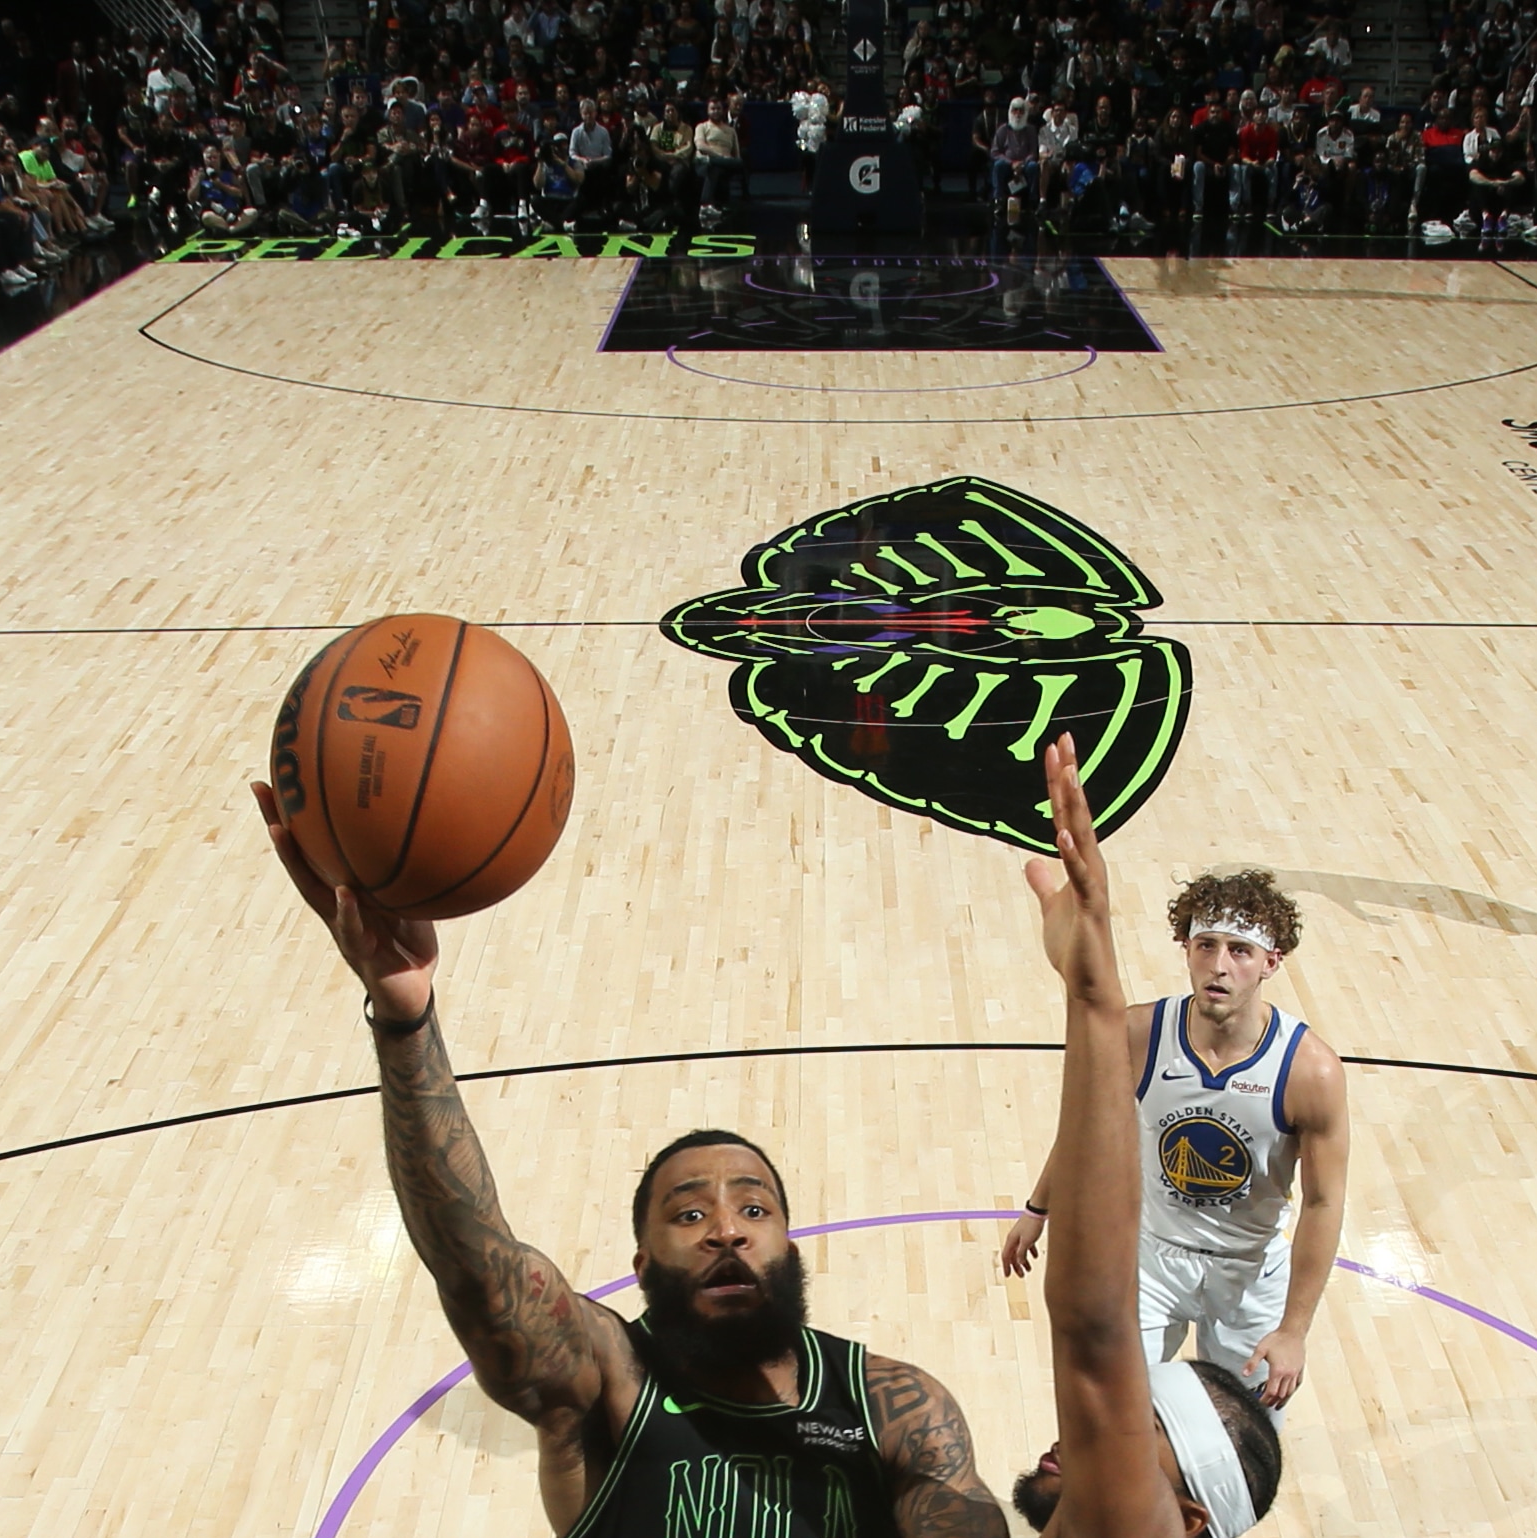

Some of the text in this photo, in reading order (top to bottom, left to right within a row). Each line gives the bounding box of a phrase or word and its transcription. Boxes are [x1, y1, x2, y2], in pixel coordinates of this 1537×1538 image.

[155, 229, 758, 263] PELICANS
[1231, 1080, 1270, 1094] Rakuten
[1158, 1106, 1254, 1145] GOLDEN STATE
[1218, 1145, 1236, 1166] 2
[1160, 1173, 1252, 1208] WARRIORS
[796, 1421, 865, 1442] NEWAGE
